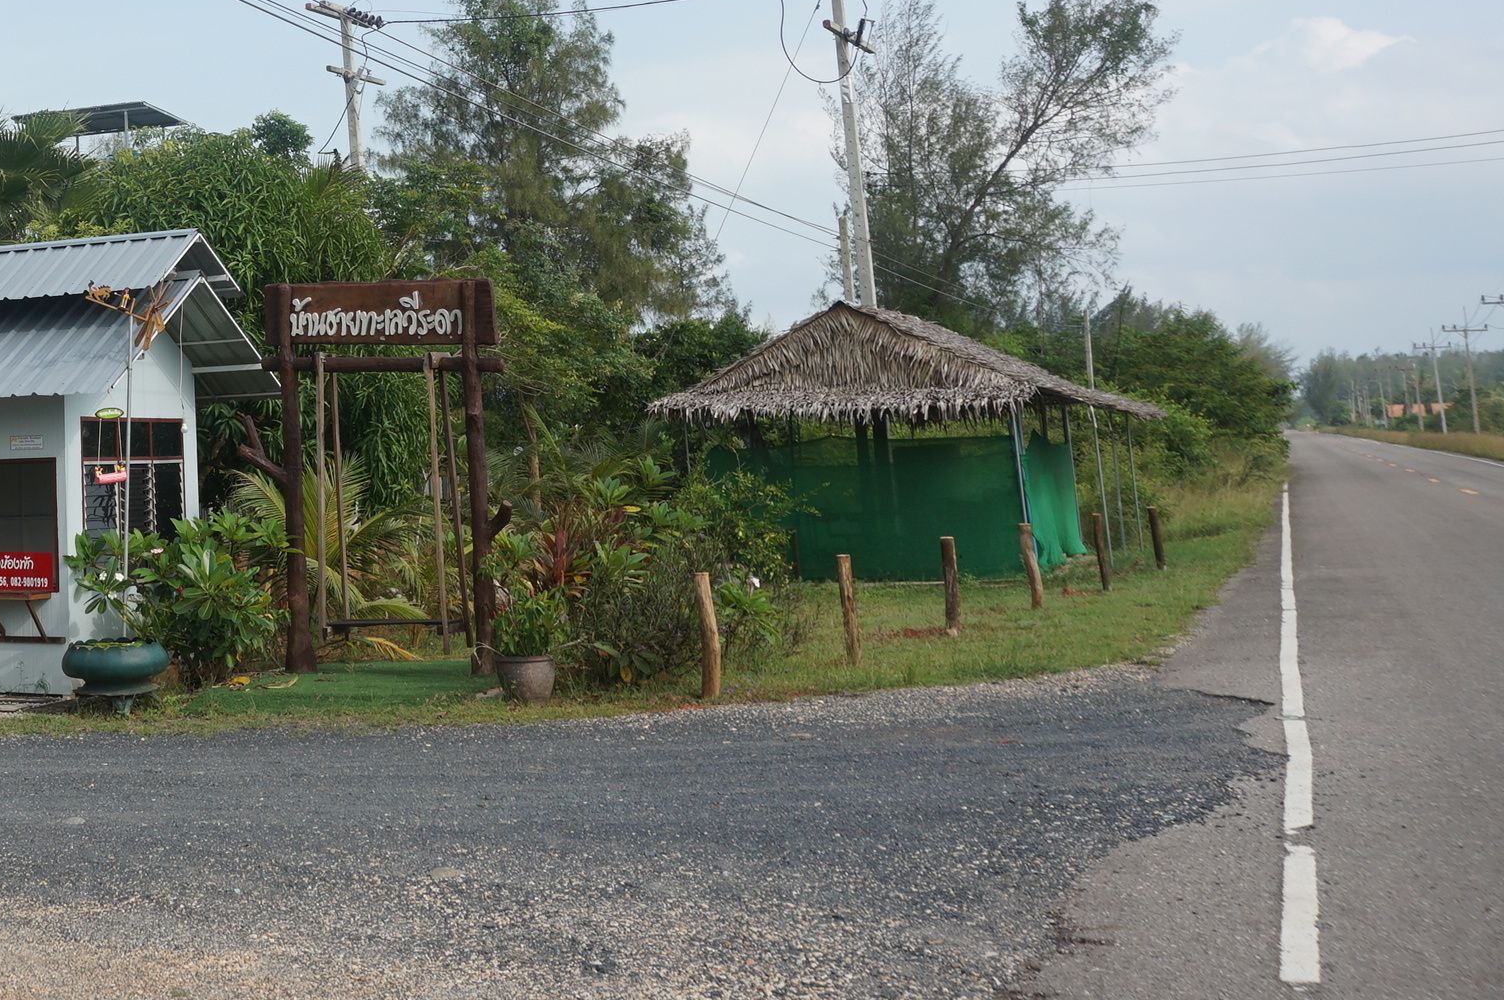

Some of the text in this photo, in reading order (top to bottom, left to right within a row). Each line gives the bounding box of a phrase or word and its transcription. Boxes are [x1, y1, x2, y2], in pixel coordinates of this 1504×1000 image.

[290, 291, 463, 337] บ้านชายทะเลวีระดา
